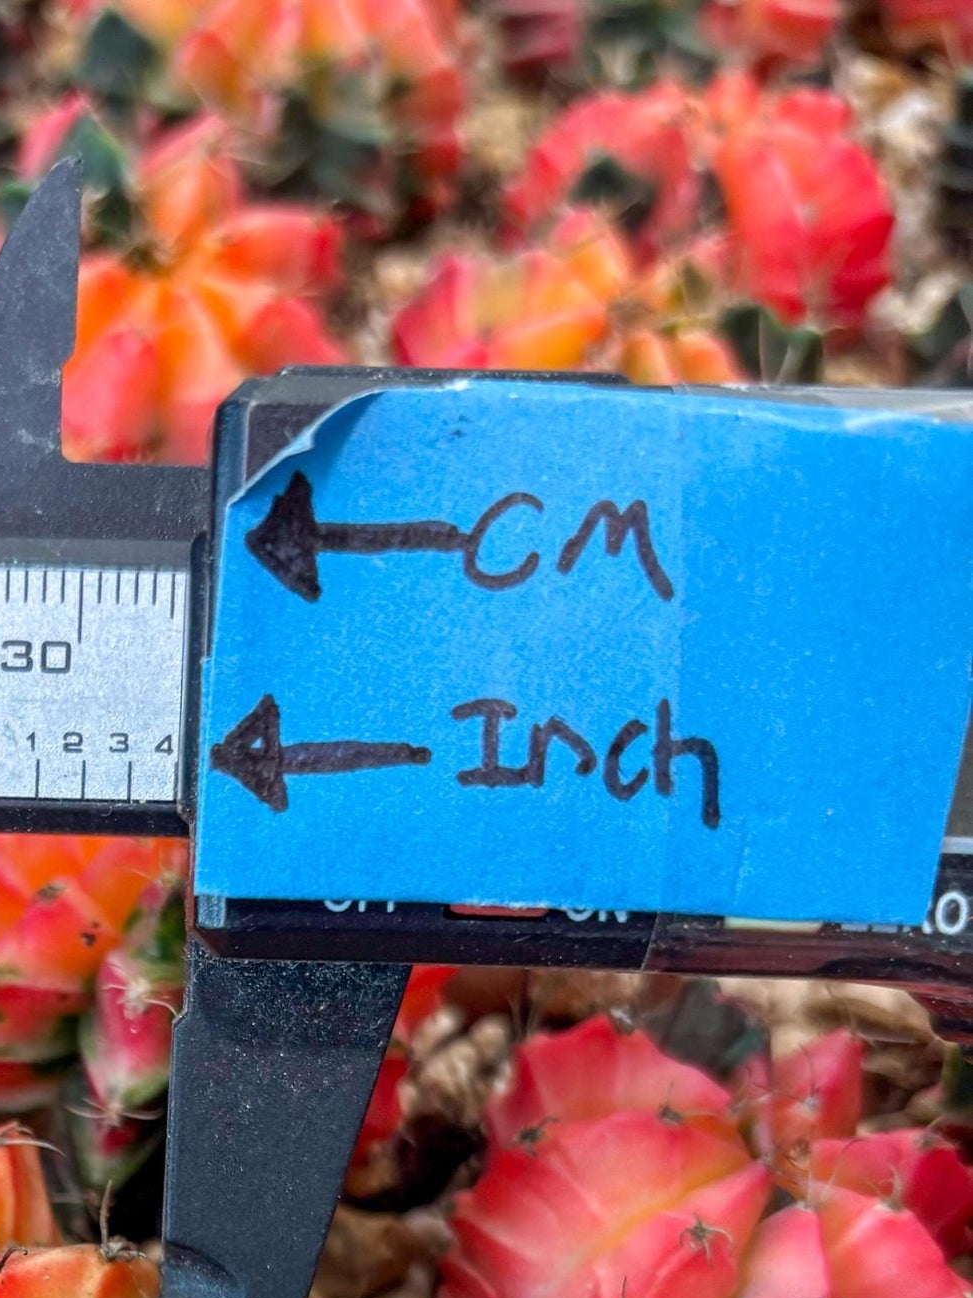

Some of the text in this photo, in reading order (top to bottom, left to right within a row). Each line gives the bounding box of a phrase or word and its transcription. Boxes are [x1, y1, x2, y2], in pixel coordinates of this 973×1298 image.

[0, 640, 72, 674] 30
[26, 732, 37, 752] 1
[62, 732, 84, 752] 2
[109, 733, 130, 753] 3
[154, 734, 174, 756] 4
[450, 697, 720, 829] Inch
